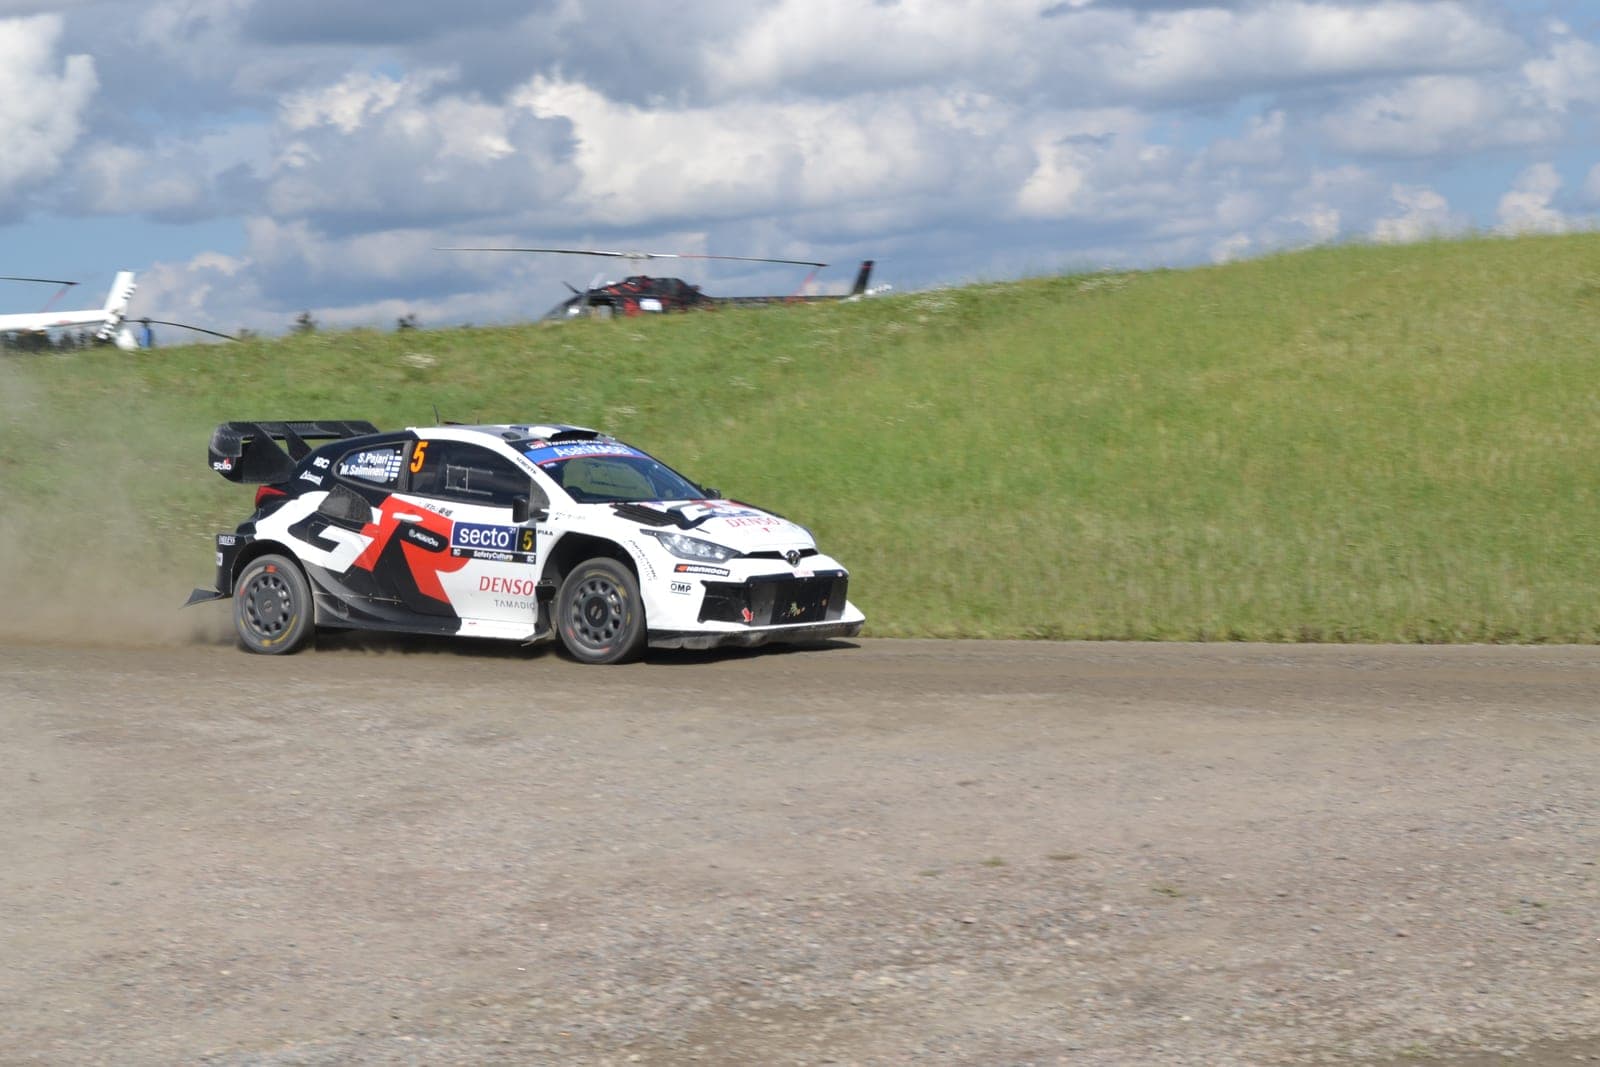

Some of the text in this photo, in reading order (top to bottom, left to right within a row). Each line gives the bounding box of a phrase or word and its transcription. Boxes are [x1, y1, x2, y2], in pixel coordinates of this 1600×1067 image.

[410, 441, 429, 473] 5
[726, 517, 780, 528] DENSO
[459, 527, 509, 547] secto
[522, 530, 534, 550] 5
[479, 576, 534, 596] DENSO
[670, 583, 692, 593] OMP
